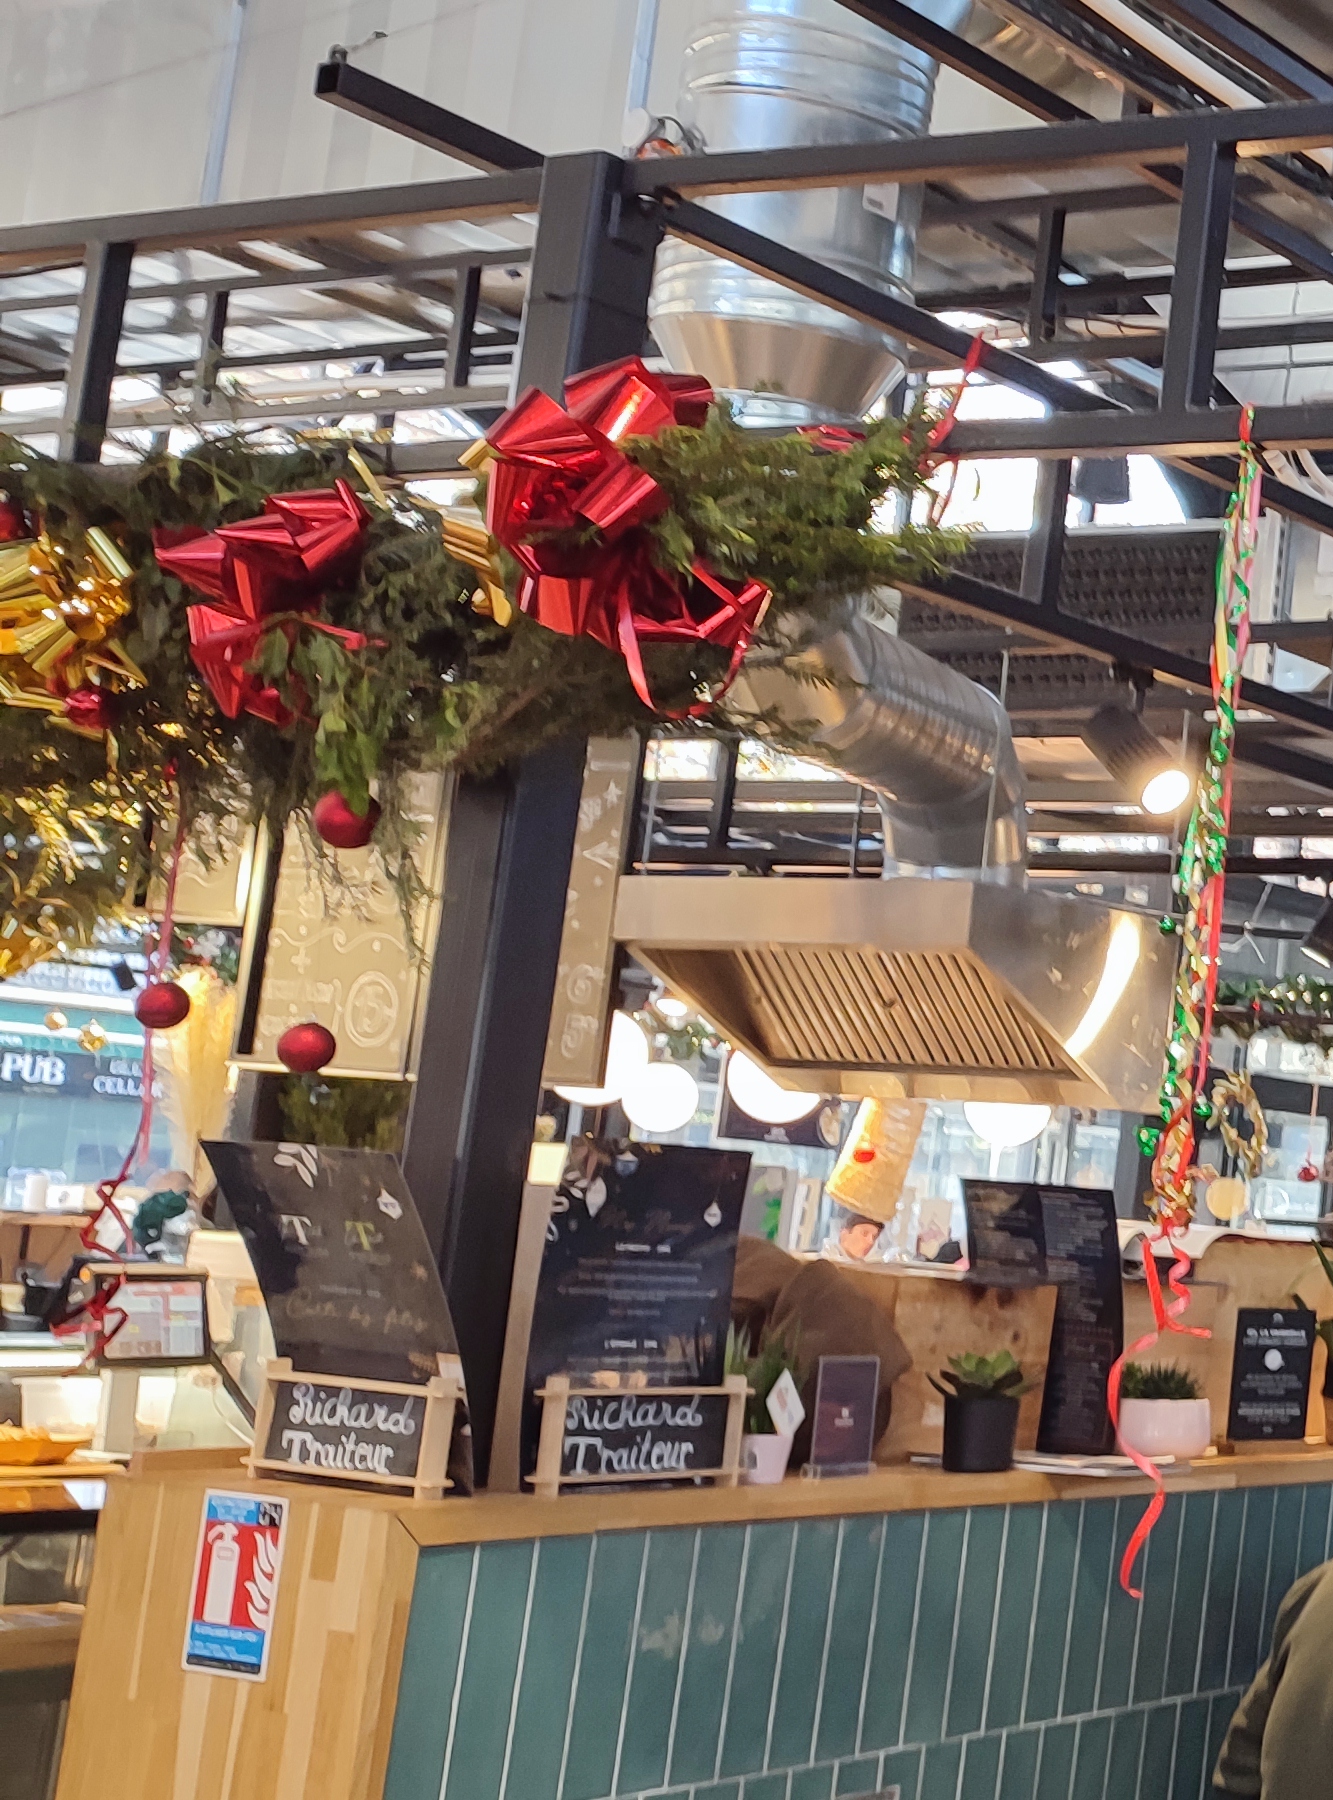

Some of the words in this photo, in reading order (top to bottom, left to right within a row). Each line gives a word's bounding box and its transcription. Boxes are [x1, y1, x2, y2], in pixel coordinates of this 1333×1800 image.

[1, 1052, 66, 1086] PUB
[288, 1382, 416, 1435] Richard
[566, 1394, 703, 1431] Richard
[281, 1428, 395, 1476] Traiteur
[563, 1430, 695, 1477] Traiteur
